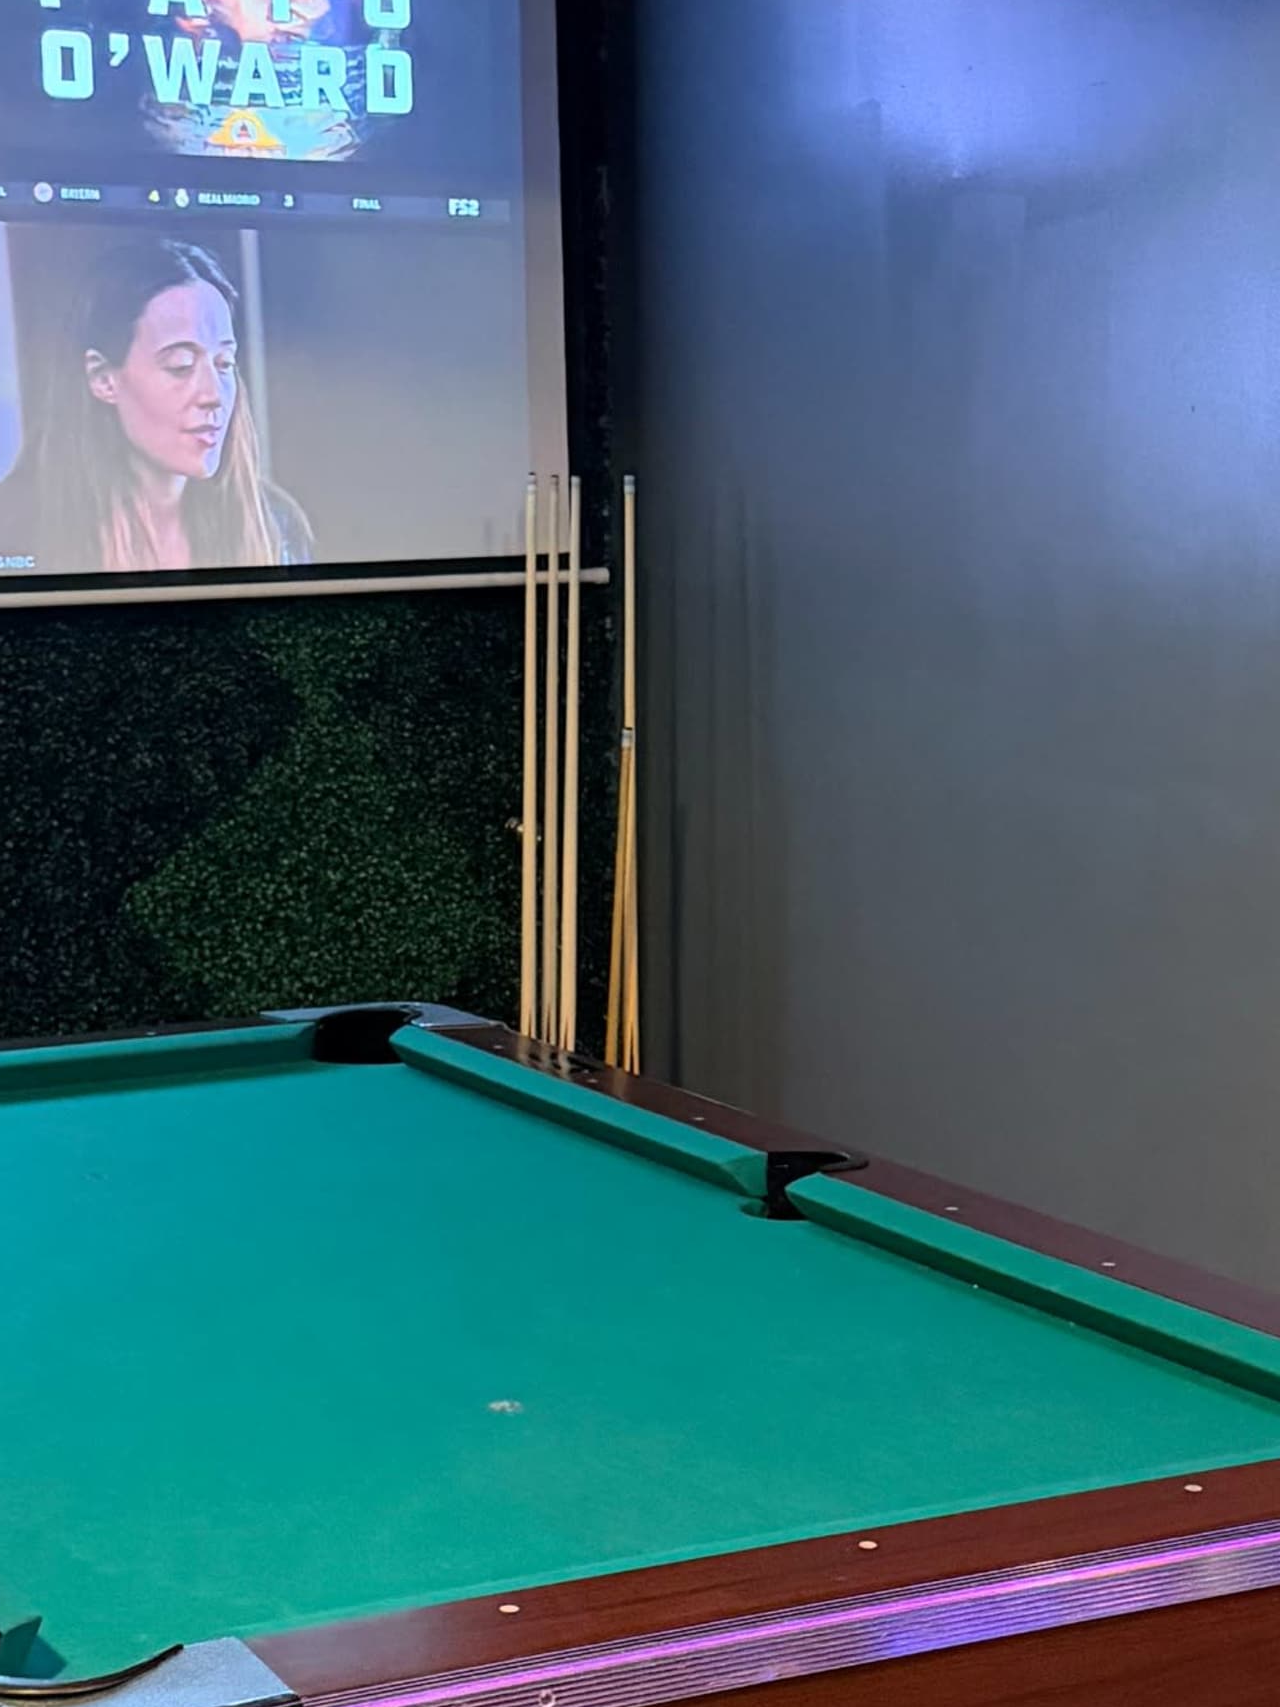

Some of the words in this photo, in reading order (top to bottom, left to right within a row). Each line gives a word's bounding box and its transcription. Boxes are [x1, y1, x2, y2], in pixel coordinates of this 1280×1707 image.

[41, 29, 414, 114] O'WARD
[352, 197, 382, 211] FINAL
[448, 198, 480, 217] FS2
